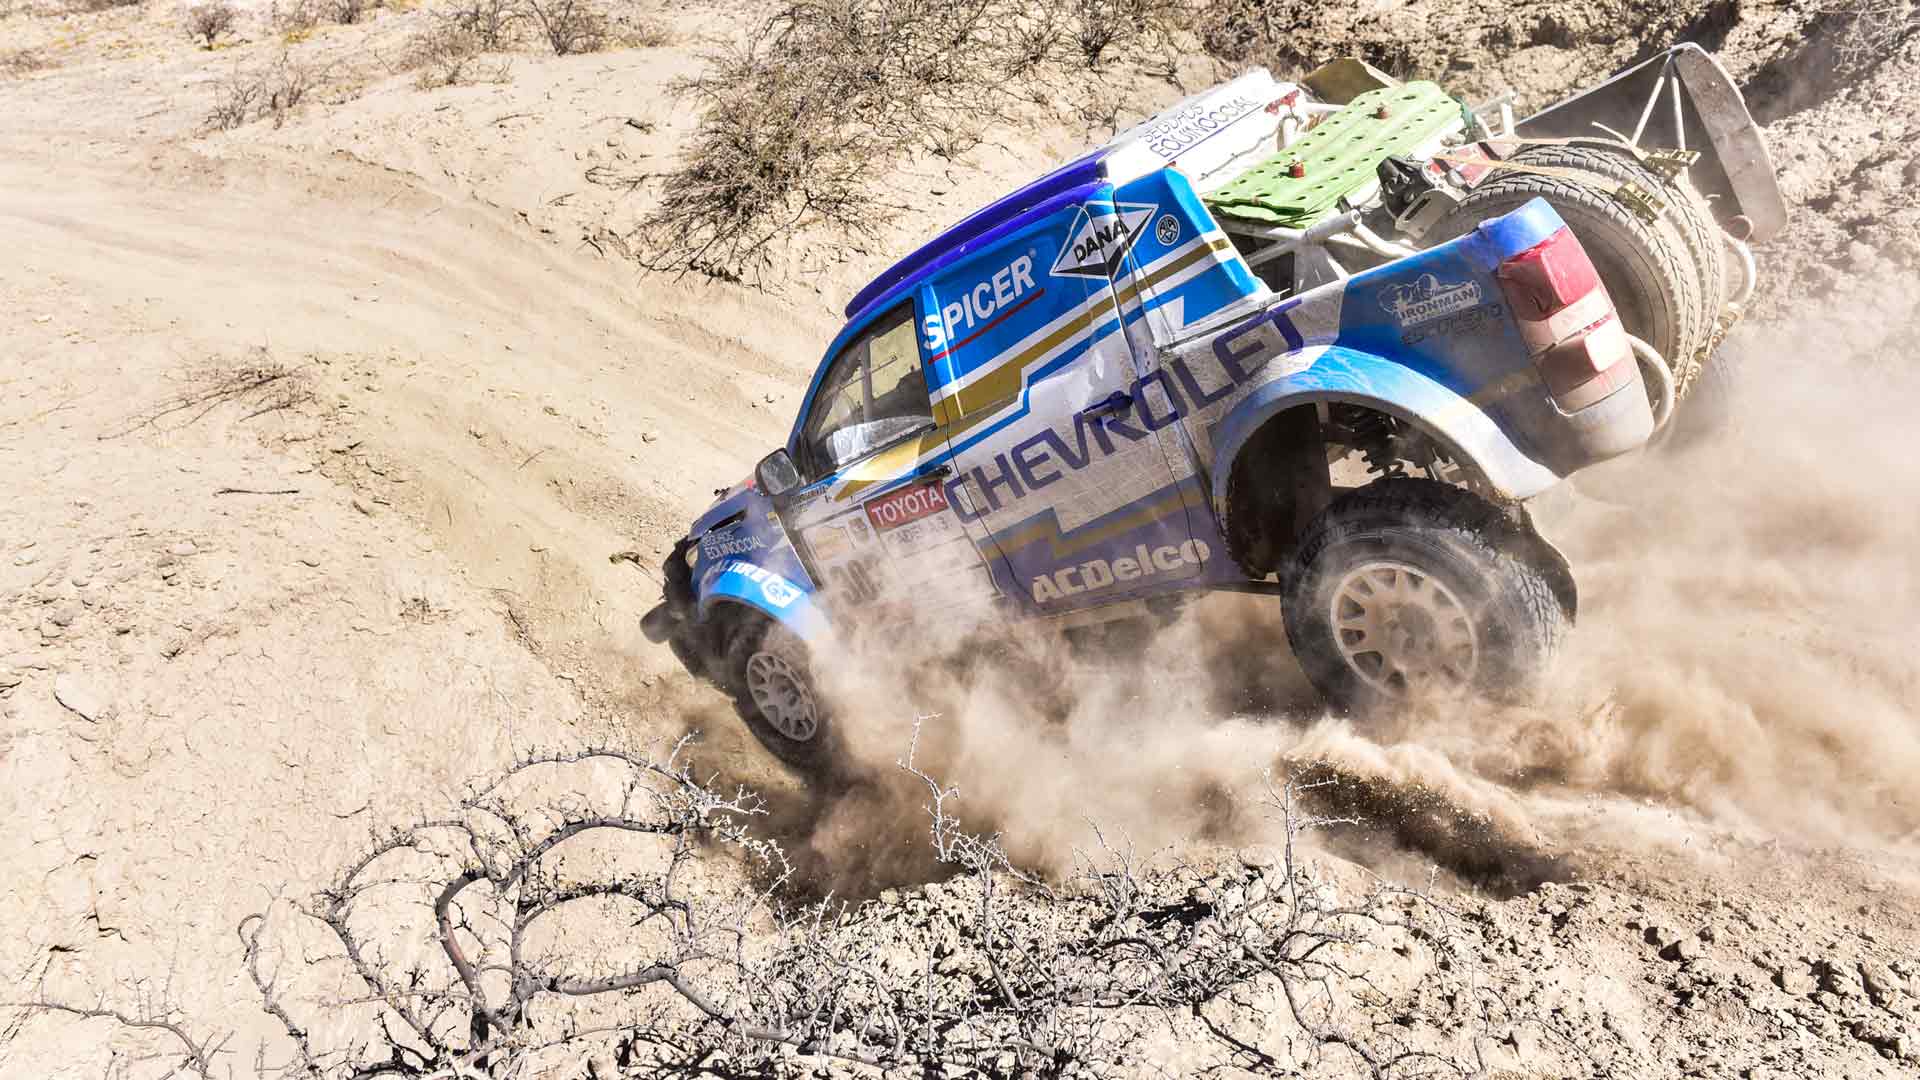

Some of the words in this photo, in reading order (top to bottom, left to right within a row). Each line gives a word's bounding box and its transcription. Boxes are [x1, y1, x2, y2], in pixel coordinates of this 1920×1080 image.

[1073, 219, 1131, 264] DANA
[1400, 286, 1475, 321] IRONMAN
[942, 296, 1305, 525] CHEVROLET
[871, 485, 944, 527] TOYOTA
[1030, 537, 1212, 604] ACDelco
